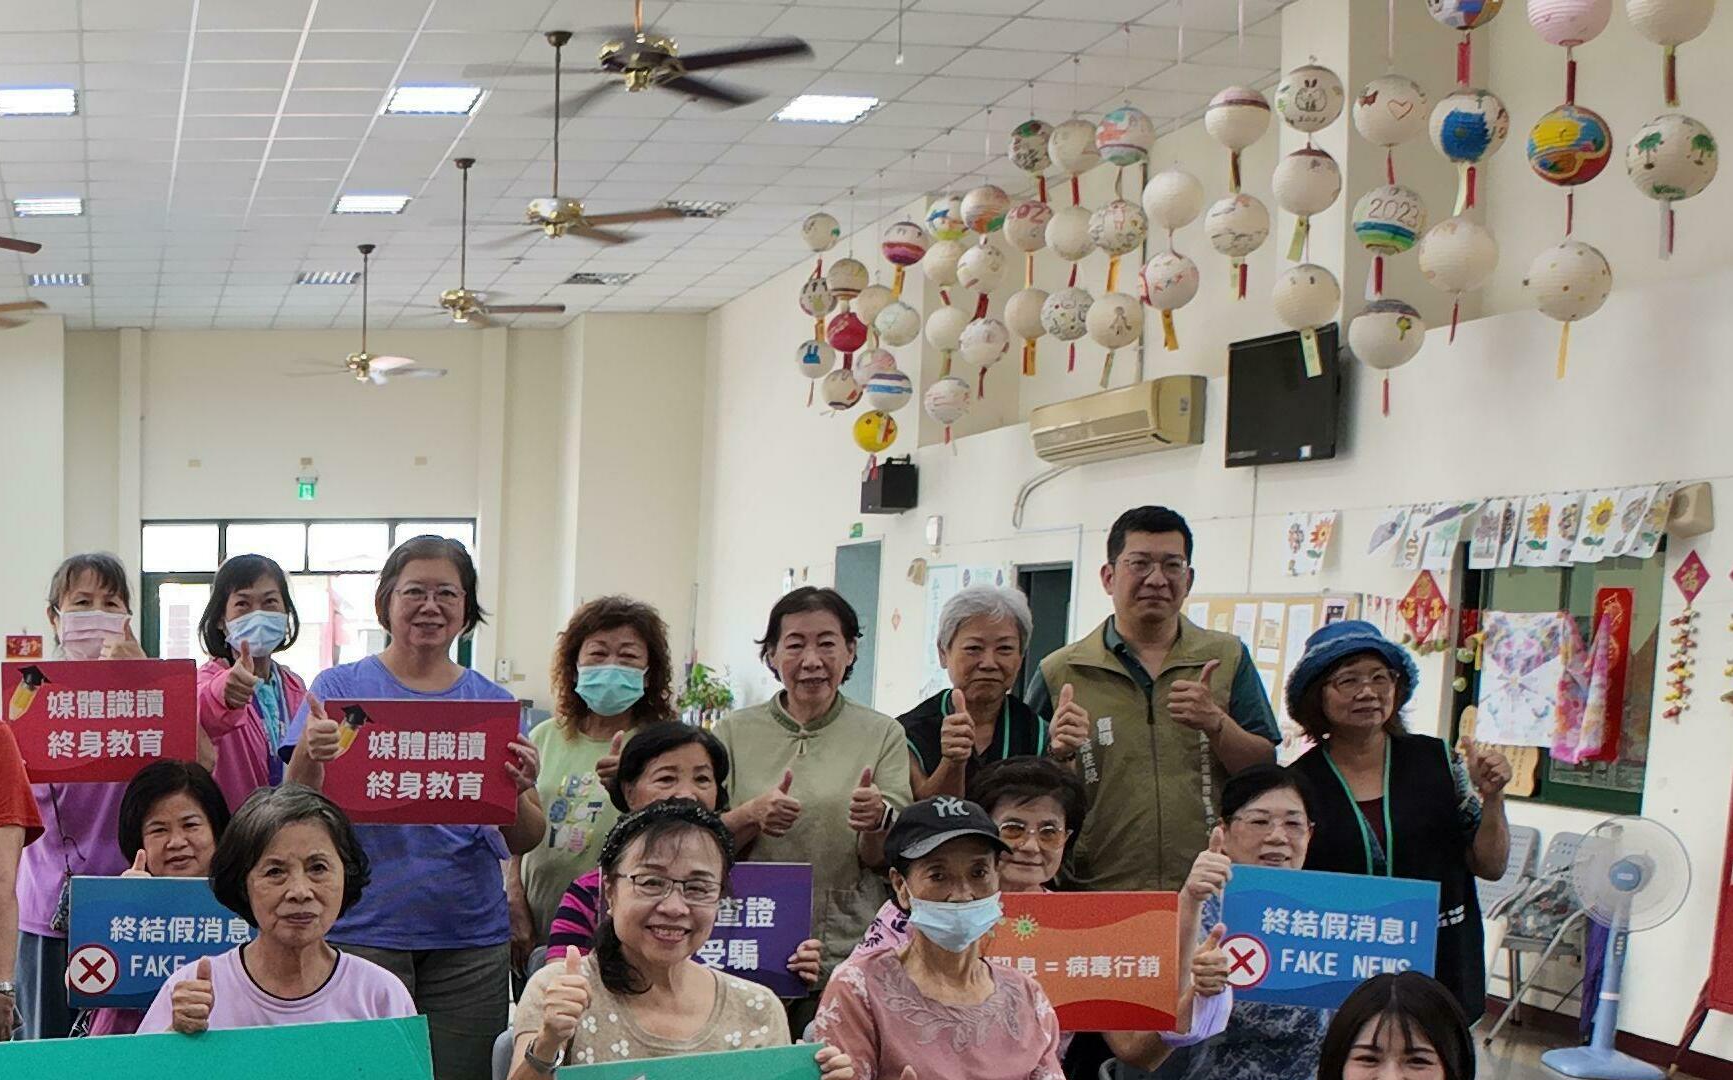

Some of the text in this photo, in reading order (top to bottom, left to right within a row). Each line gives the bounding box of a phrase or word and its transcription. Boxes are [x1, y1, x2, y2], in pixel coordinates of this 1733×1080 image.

[46, 689, 165, 720] 媒體識讀
[47, 729, 163, 759] 終身教育
[368, 731, 487, 762] 媒體識讀
[366, 771, 485, 801] 終身教育
[714, 896, 776, 928] 查證
[1261, 906, 1419, 945] 終結假消息!
[109, 915, 252, 944] 終結假消息
[696, 939, 759, 971] 受騙
[1066, 955, 1161, 979] 病毒行銷
[1280, 948, 1339, 977] FAKE
